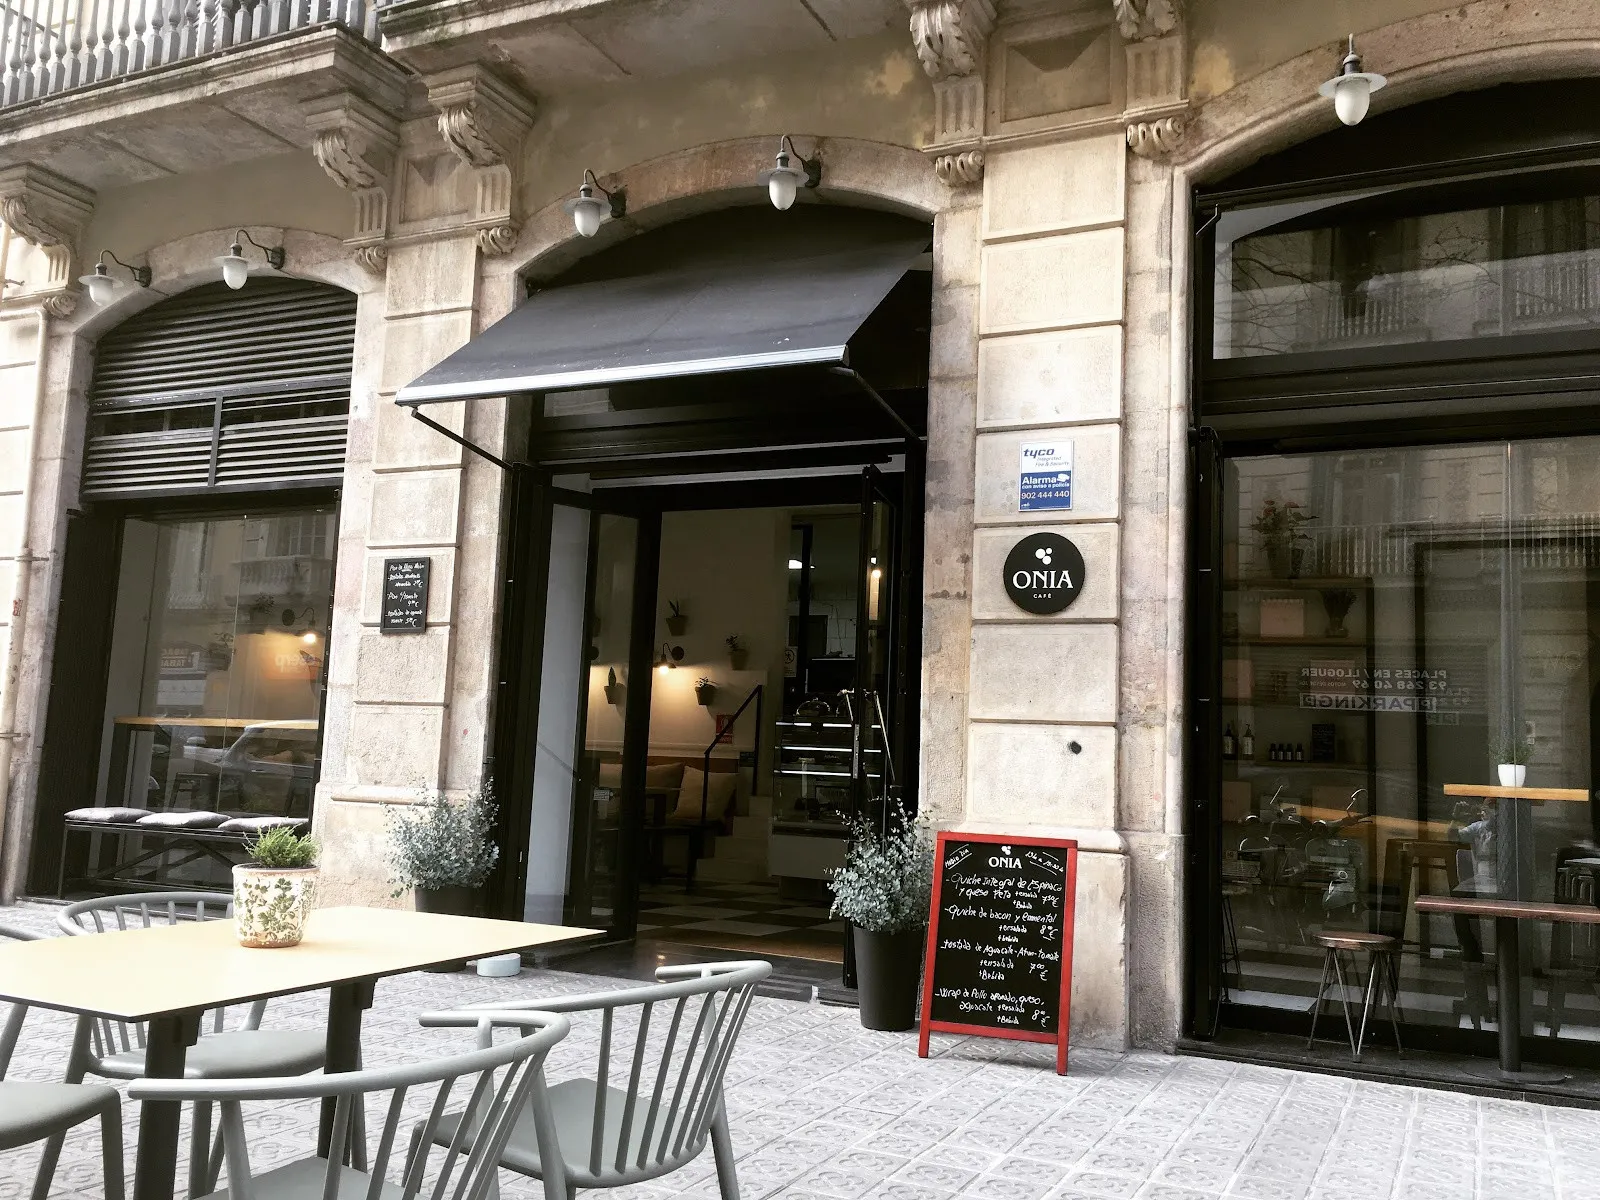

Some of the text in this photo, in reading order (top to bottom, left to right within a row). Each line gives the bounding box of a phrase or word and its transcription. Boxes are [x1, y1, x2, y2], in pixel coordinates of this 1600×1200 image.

[1023, 448, 1055, 459] tyco
[1022, 476, 1057, 485] Alarma
[1021, 492, 1036, 500] 902
[1054, 490, 1070, 498] 440
[1012, 570, 1074, 589] ONIA
[988, 856, 1022, 869] ONIA
[1017, 876, 1027, 888] de
[966, 888, 989, 900] queso
[979, 906, 988, 918] de
[990, 909, 1012, 920] bacon
[1014, 914, 1021, 923] y
[975, 942, 982, 952] de
[963, 988, 970, 998] de
